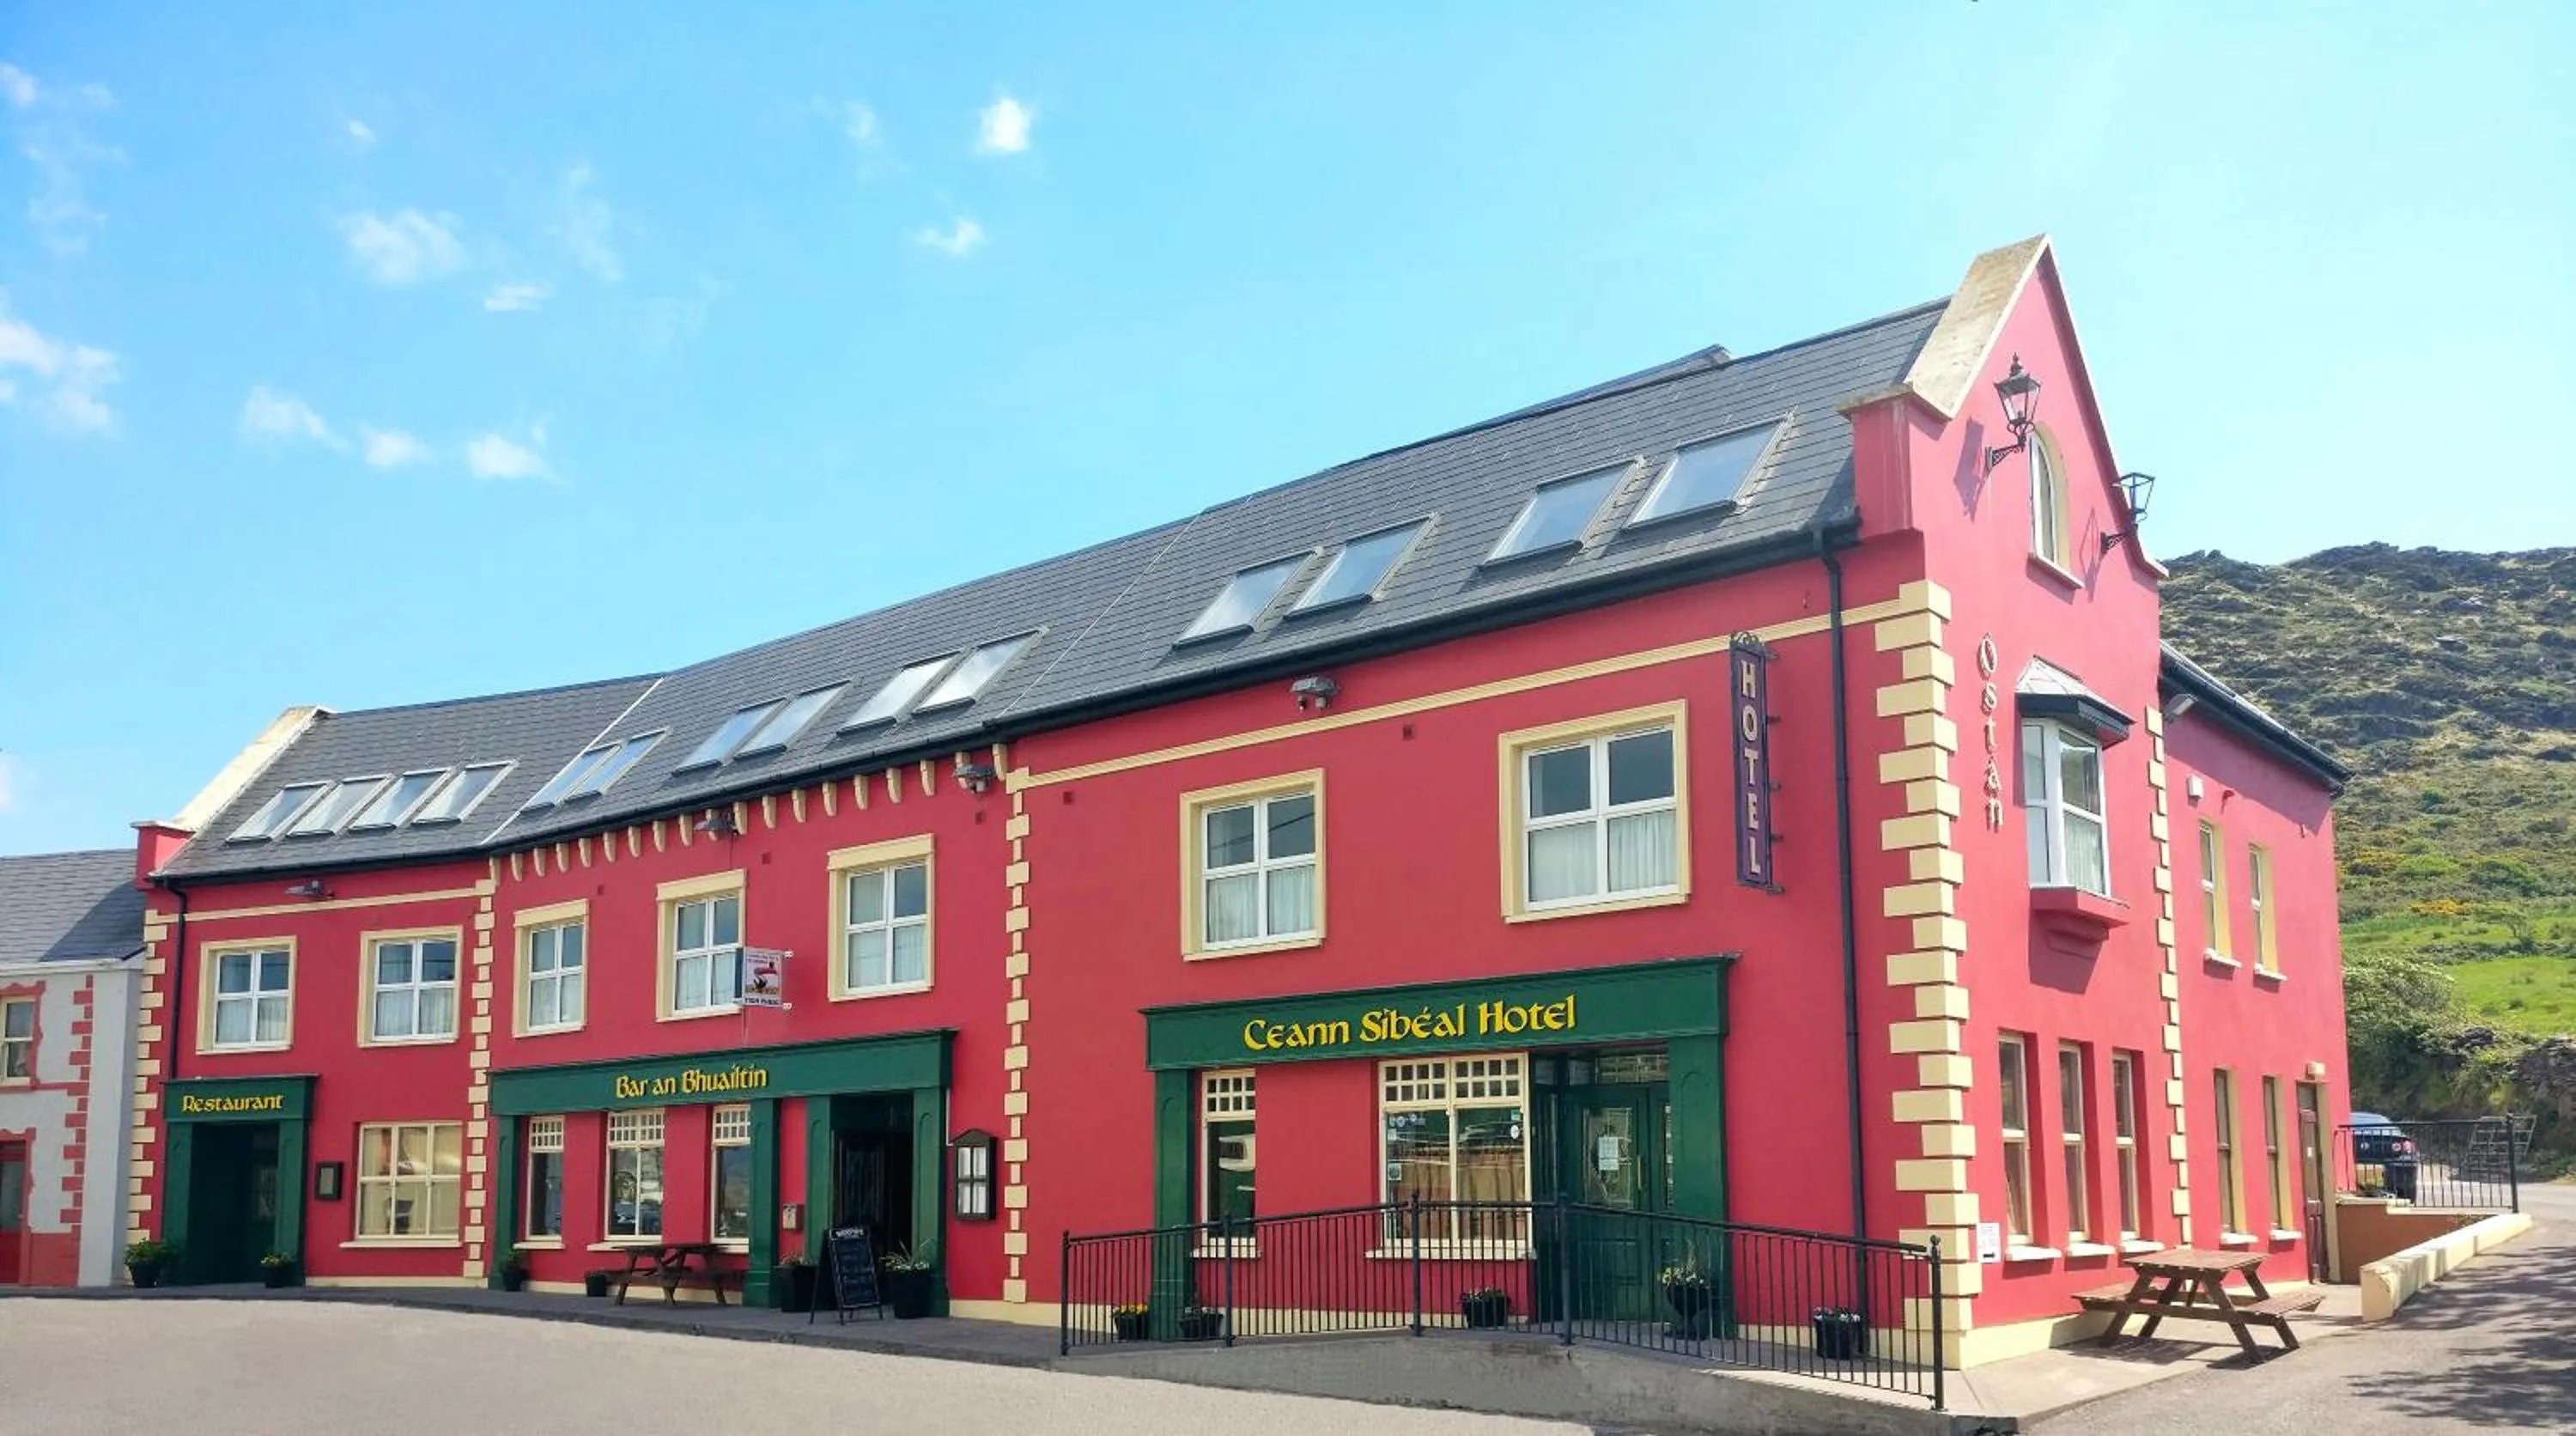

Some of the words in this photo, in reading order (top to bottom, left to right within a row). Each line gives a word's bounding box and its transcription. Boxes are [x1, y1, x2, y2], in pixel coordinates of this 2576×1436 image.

[1741, 659, 1760, 874] HOTEL
[1244, 1019, 1350, 1050] Ceann
[1479, 994, 1576, 1035] Hotel
[181, 1095, 284, 1112] Restaurant
[616, 1075, 647, 1098] Bar
[652, 1076, 676, 1095] an
